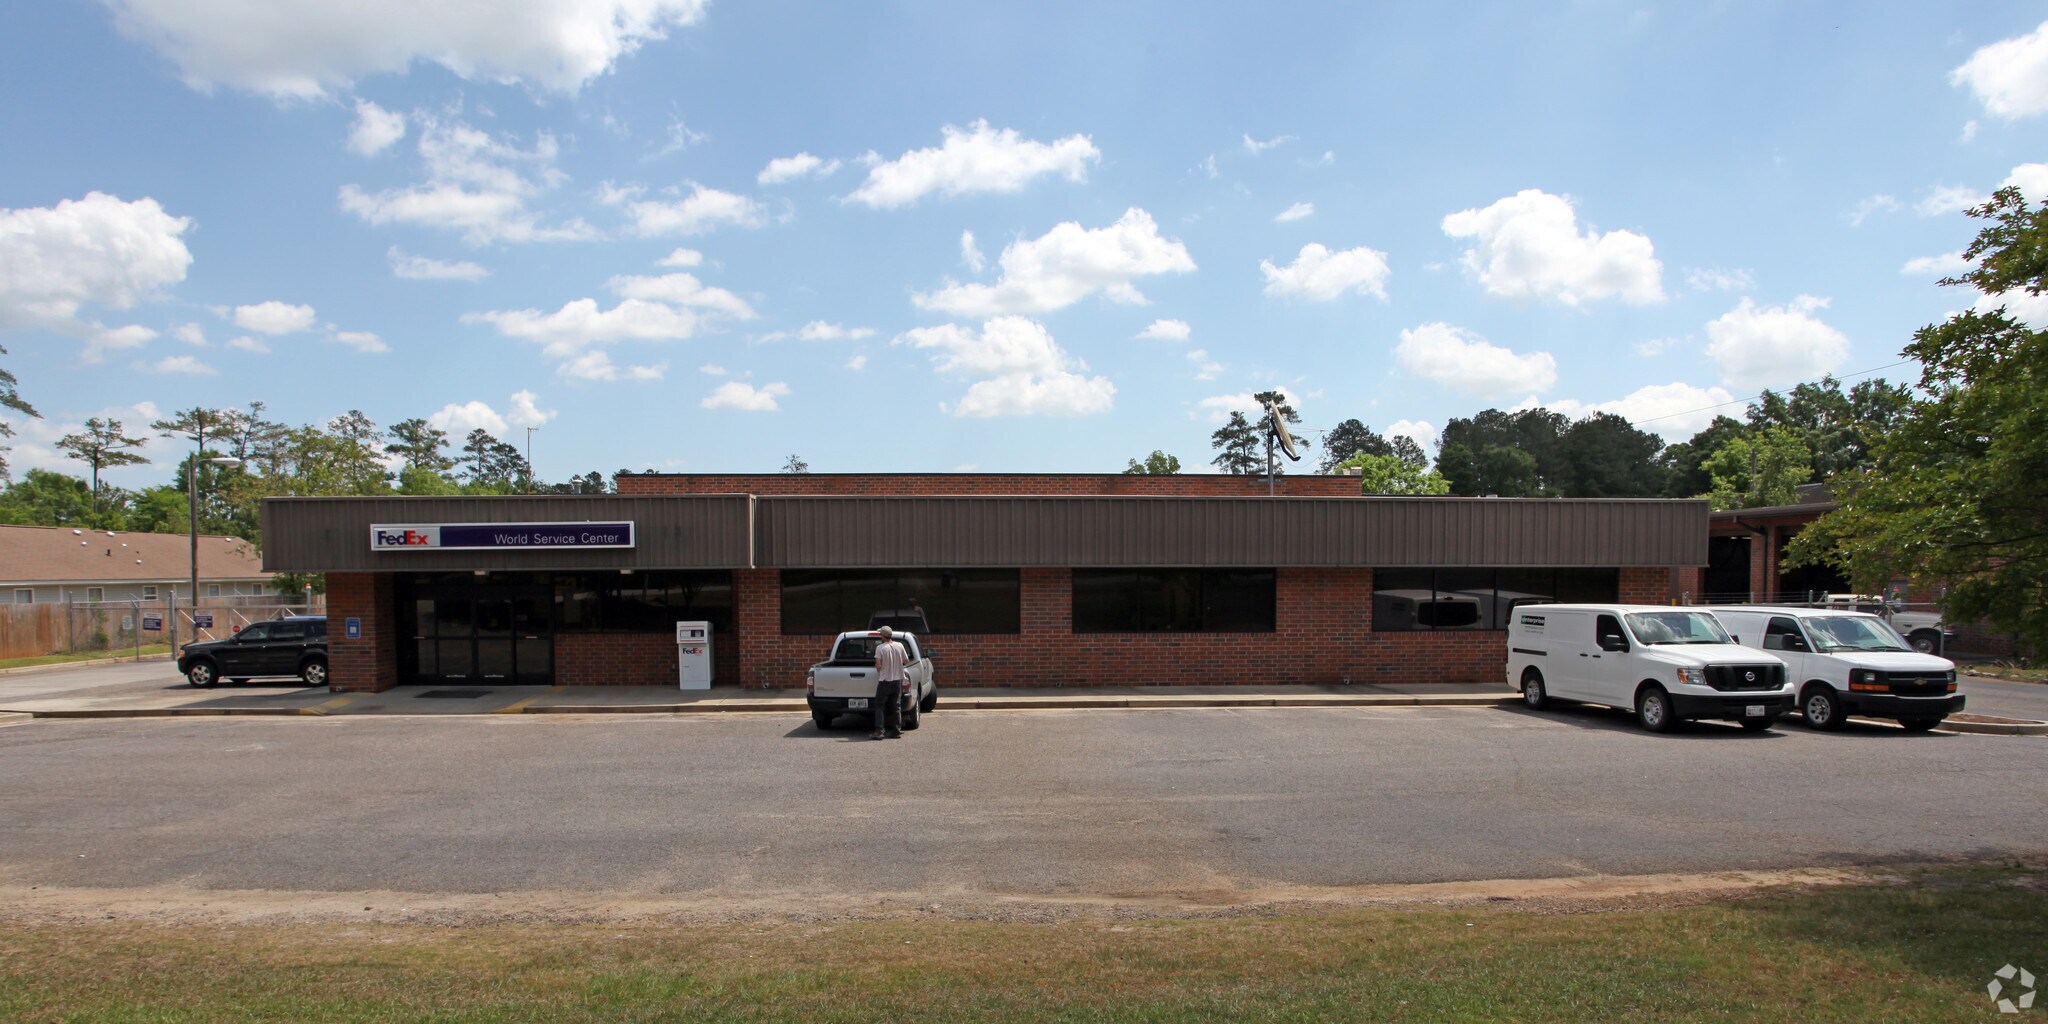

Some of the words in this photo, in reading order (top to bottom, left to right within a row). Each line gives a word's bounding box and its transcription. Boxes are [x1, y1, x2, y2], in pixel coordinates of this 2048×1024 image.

[377, 529, 429, 545] FedEx
[494, 533, 528, 544] World
[533, 533, 576, 544] Service
[581, 532, 620, 543] Center
[682, 647, 704, 655] FedEx
